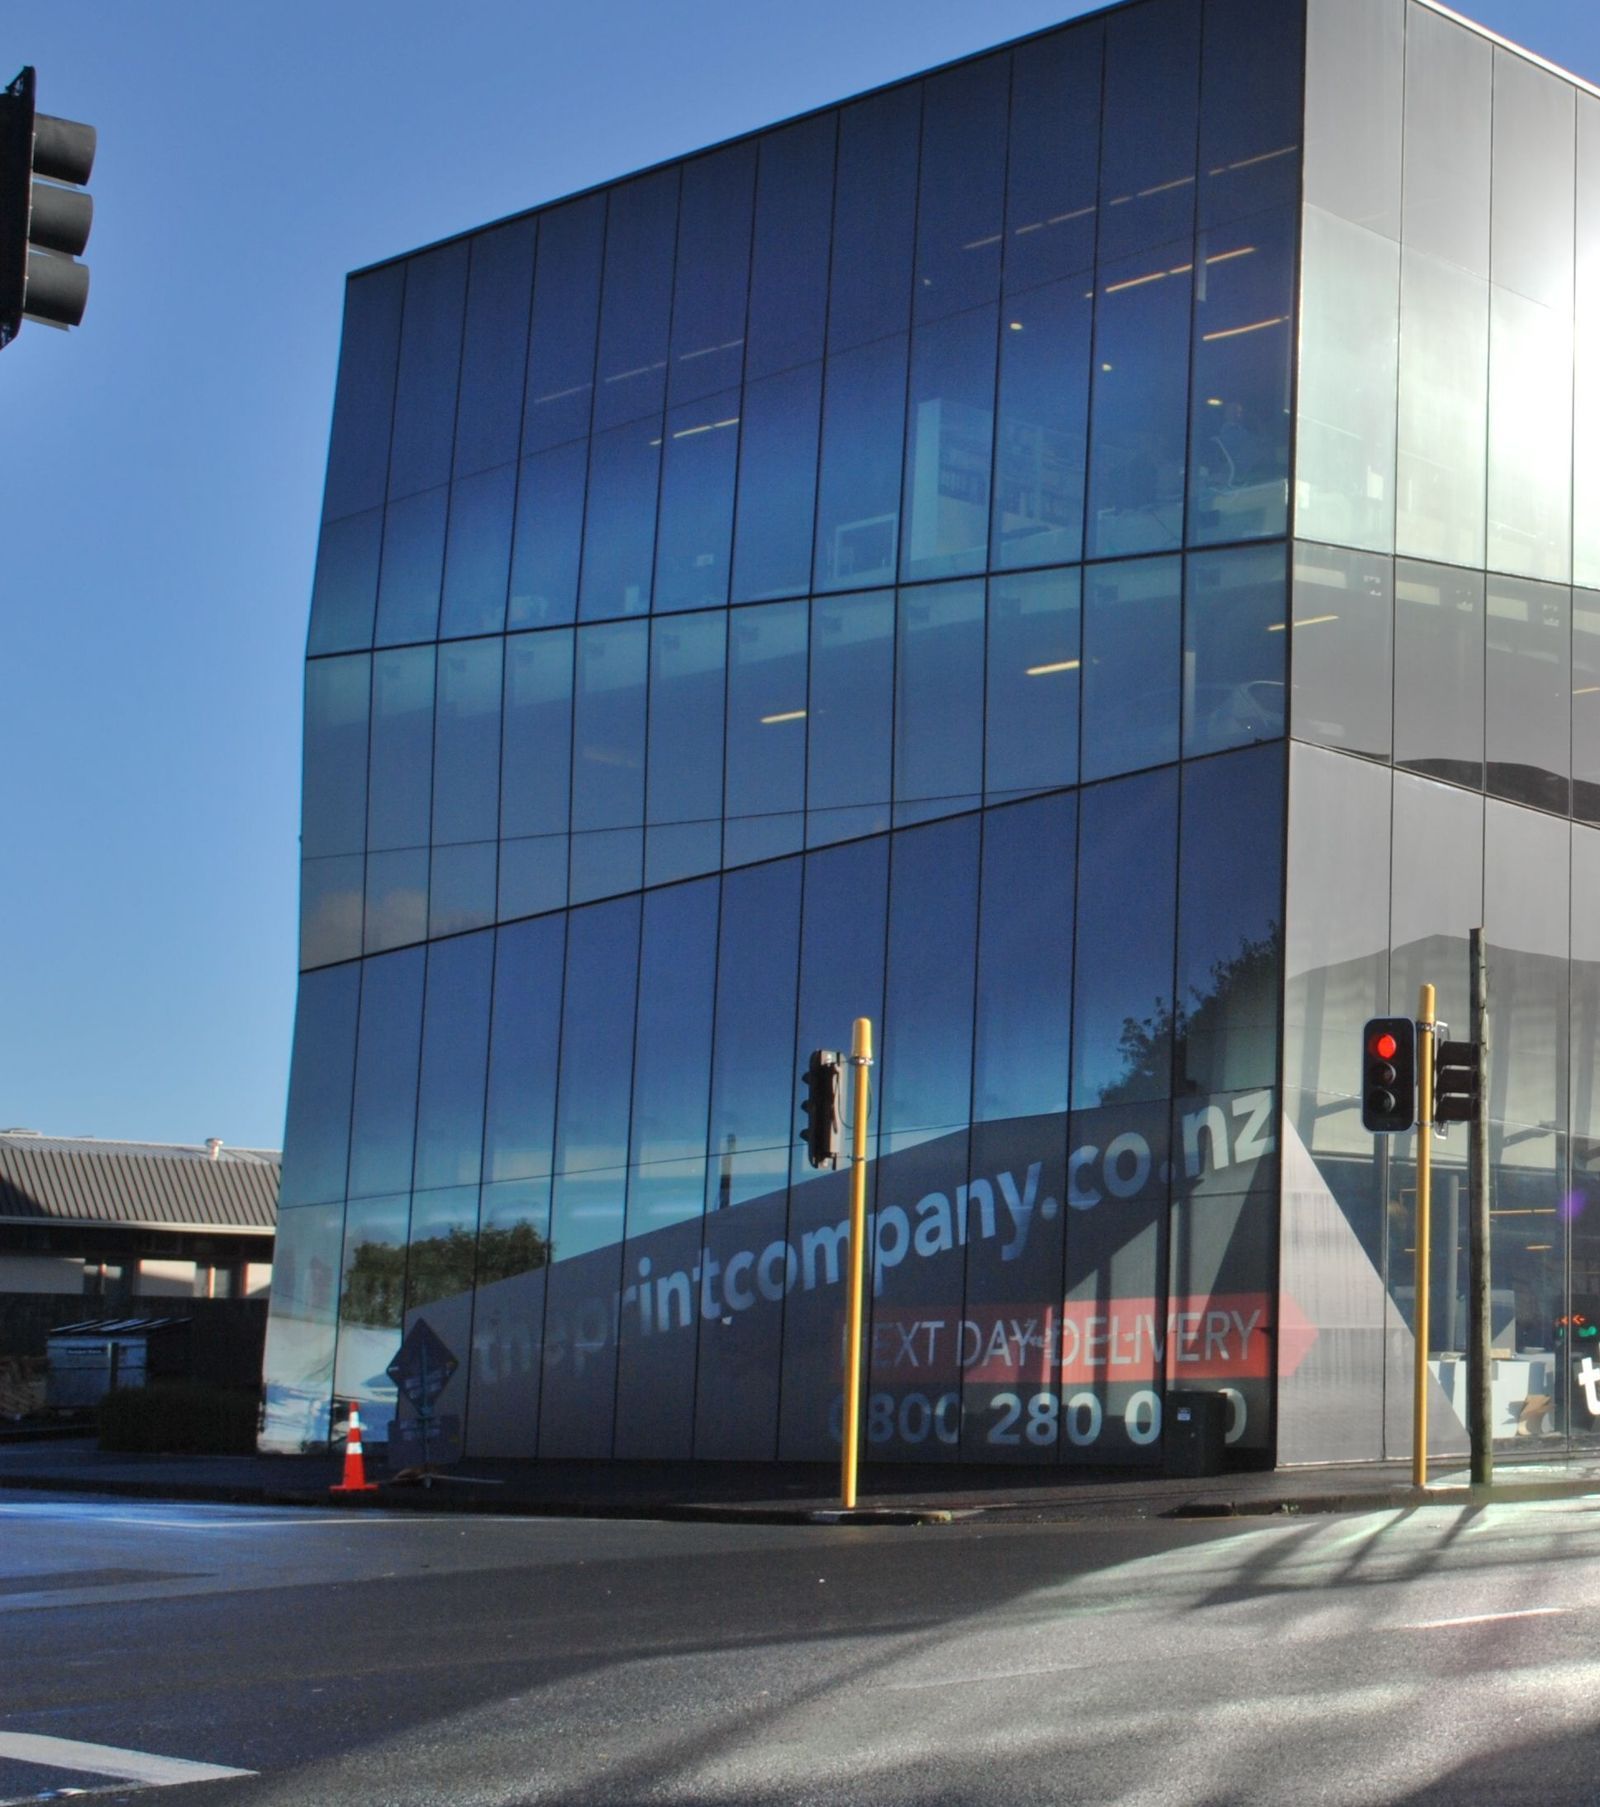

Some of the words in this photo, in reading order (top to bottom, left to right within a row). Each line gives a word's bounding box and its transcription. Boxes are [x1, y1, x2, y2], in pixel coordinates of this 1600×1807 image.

[956, 1319, 1037, 1368] DAY
[1052, 1309, 1261, 1367] DELIVERY
[987, 1391, 1101, 1446] 280
[1124, 1388, 1247, 1445] 00
